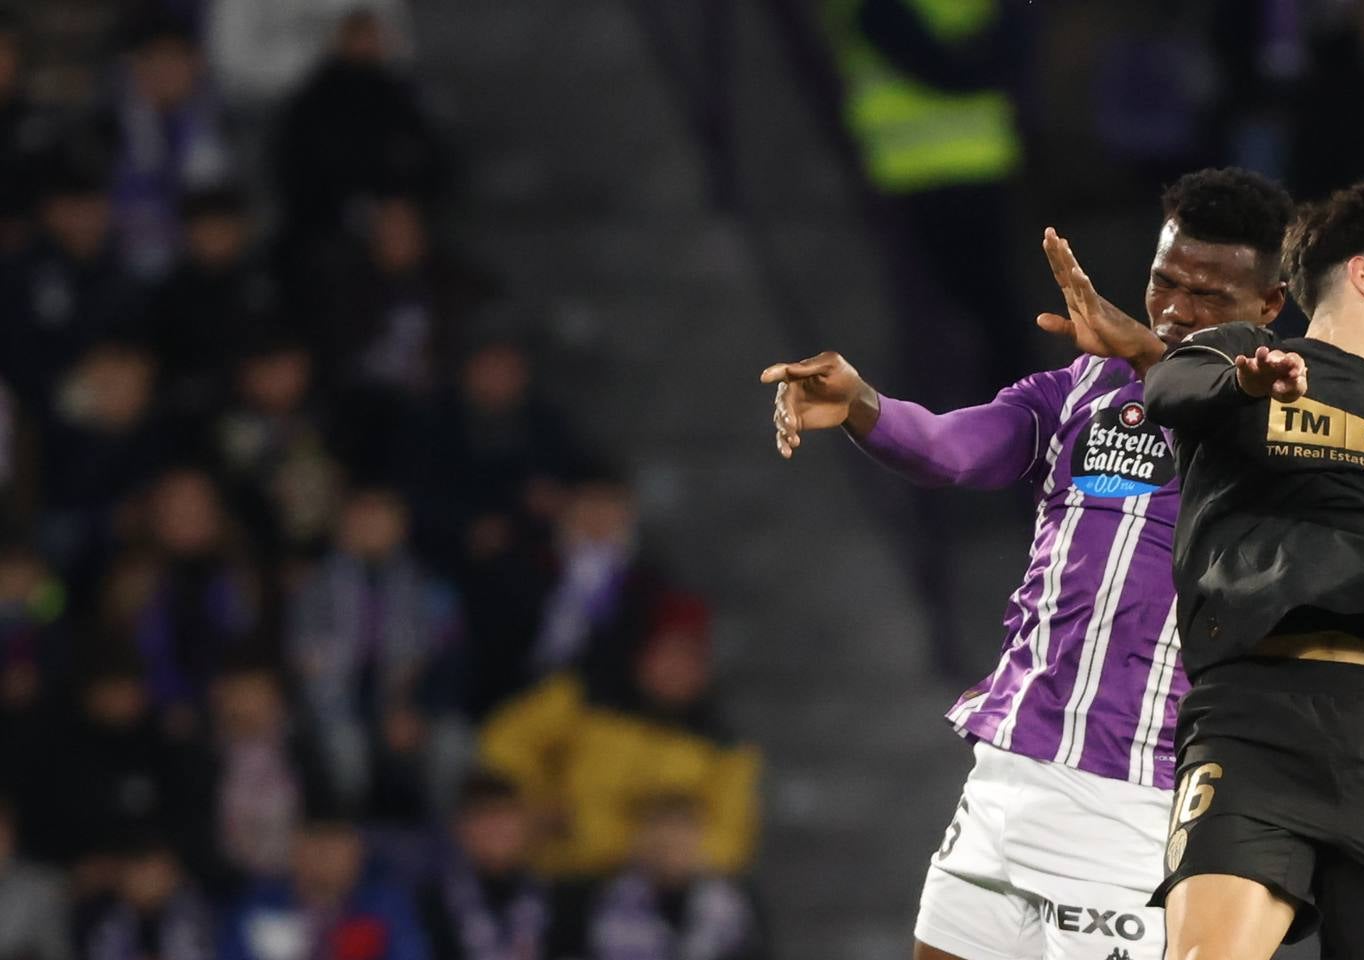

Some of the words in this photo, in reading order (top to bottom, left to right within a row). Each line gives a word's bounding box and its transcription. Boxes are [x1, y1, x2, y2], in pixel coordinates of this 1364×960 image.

[1280, 406, 1331, 437] TM
[1086, 422, 1167, 458] Estrella
[1265, 445, 1289, 457] TM
[1294, 446, 1325, 459] Real
[1083, 446, 1155, 479] Galicia
